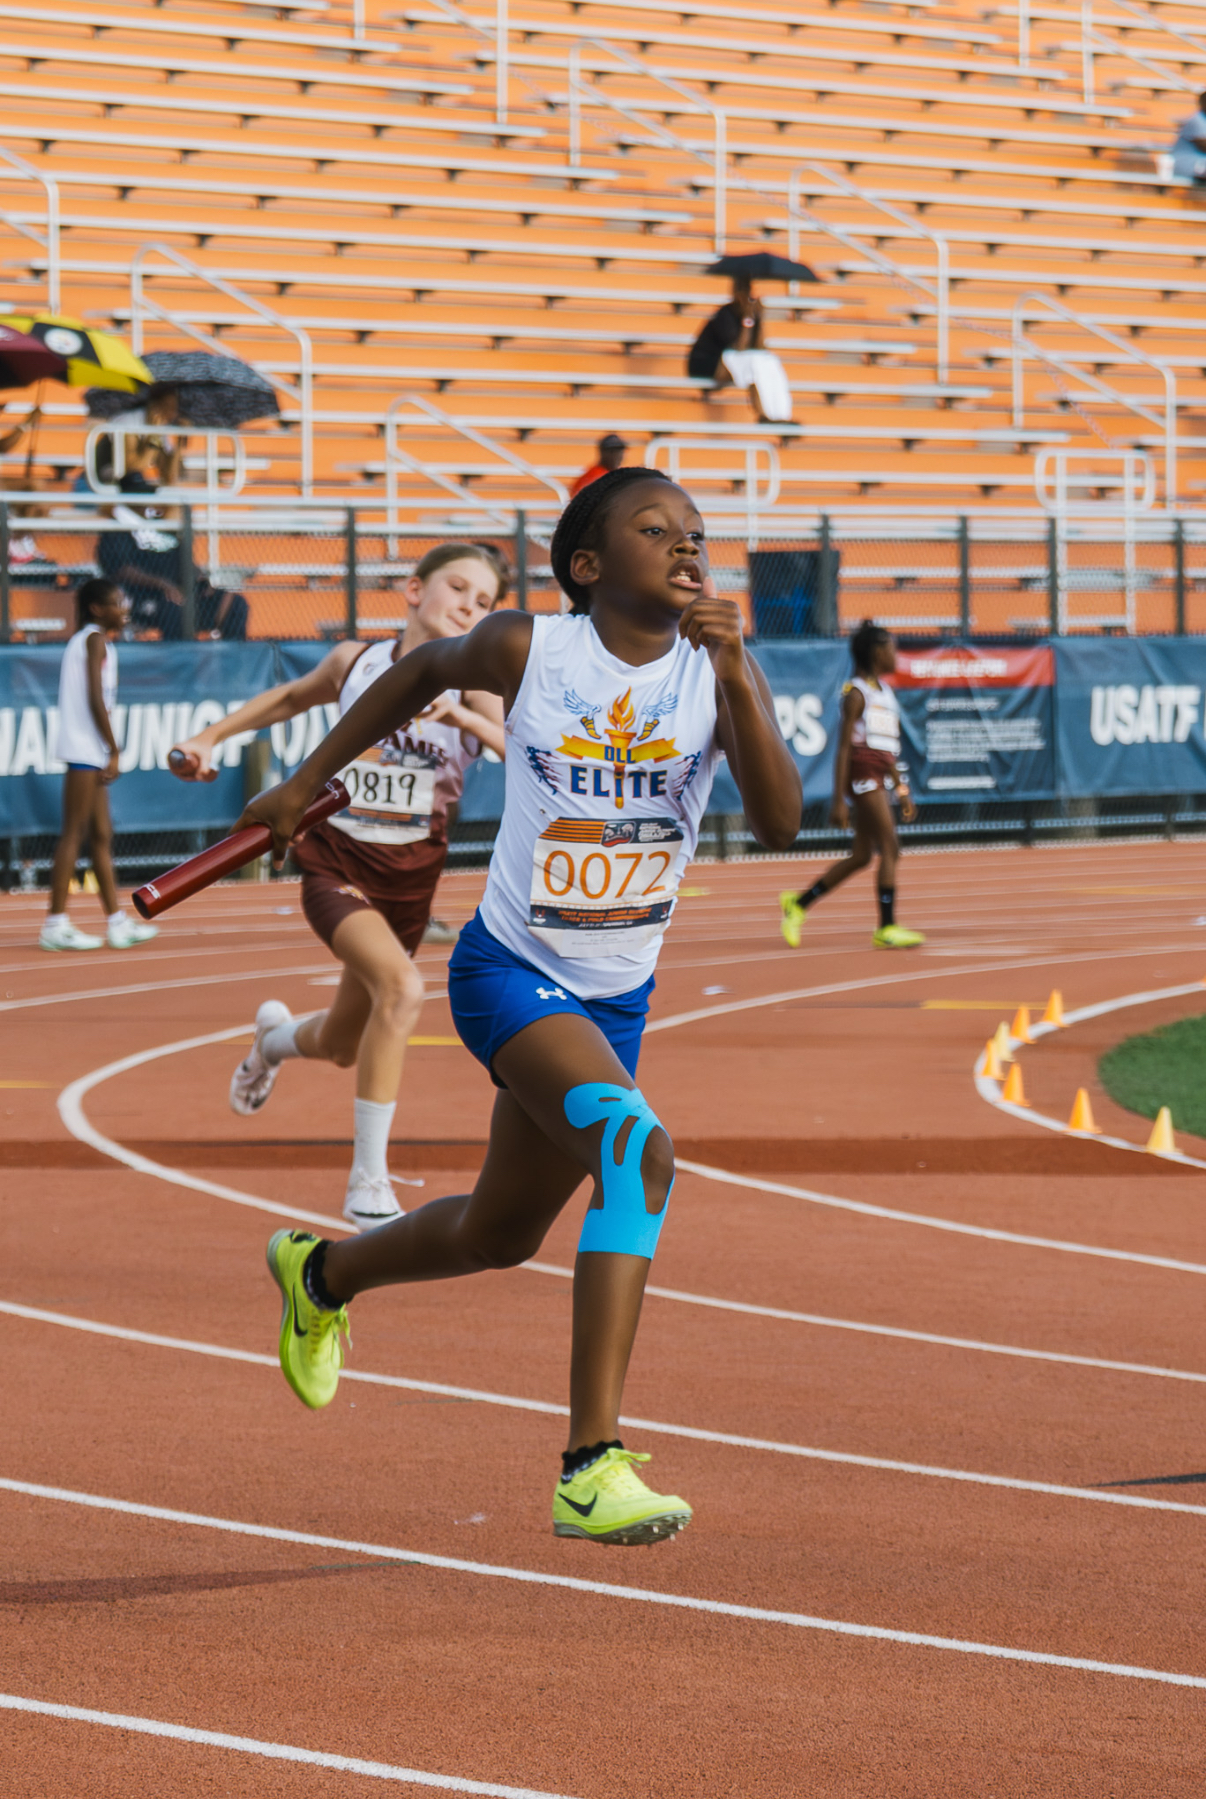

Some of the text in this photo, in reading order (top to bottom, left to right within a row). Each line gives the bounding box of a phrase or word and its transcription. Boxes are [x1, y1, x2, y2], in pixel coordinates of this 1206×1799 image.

[772, 693, 828, 757] PS
[1090, 685, 1201, 746] USATF
[343, 767, 416, 807] 0819
[543, 850, 671, 899] 0072
